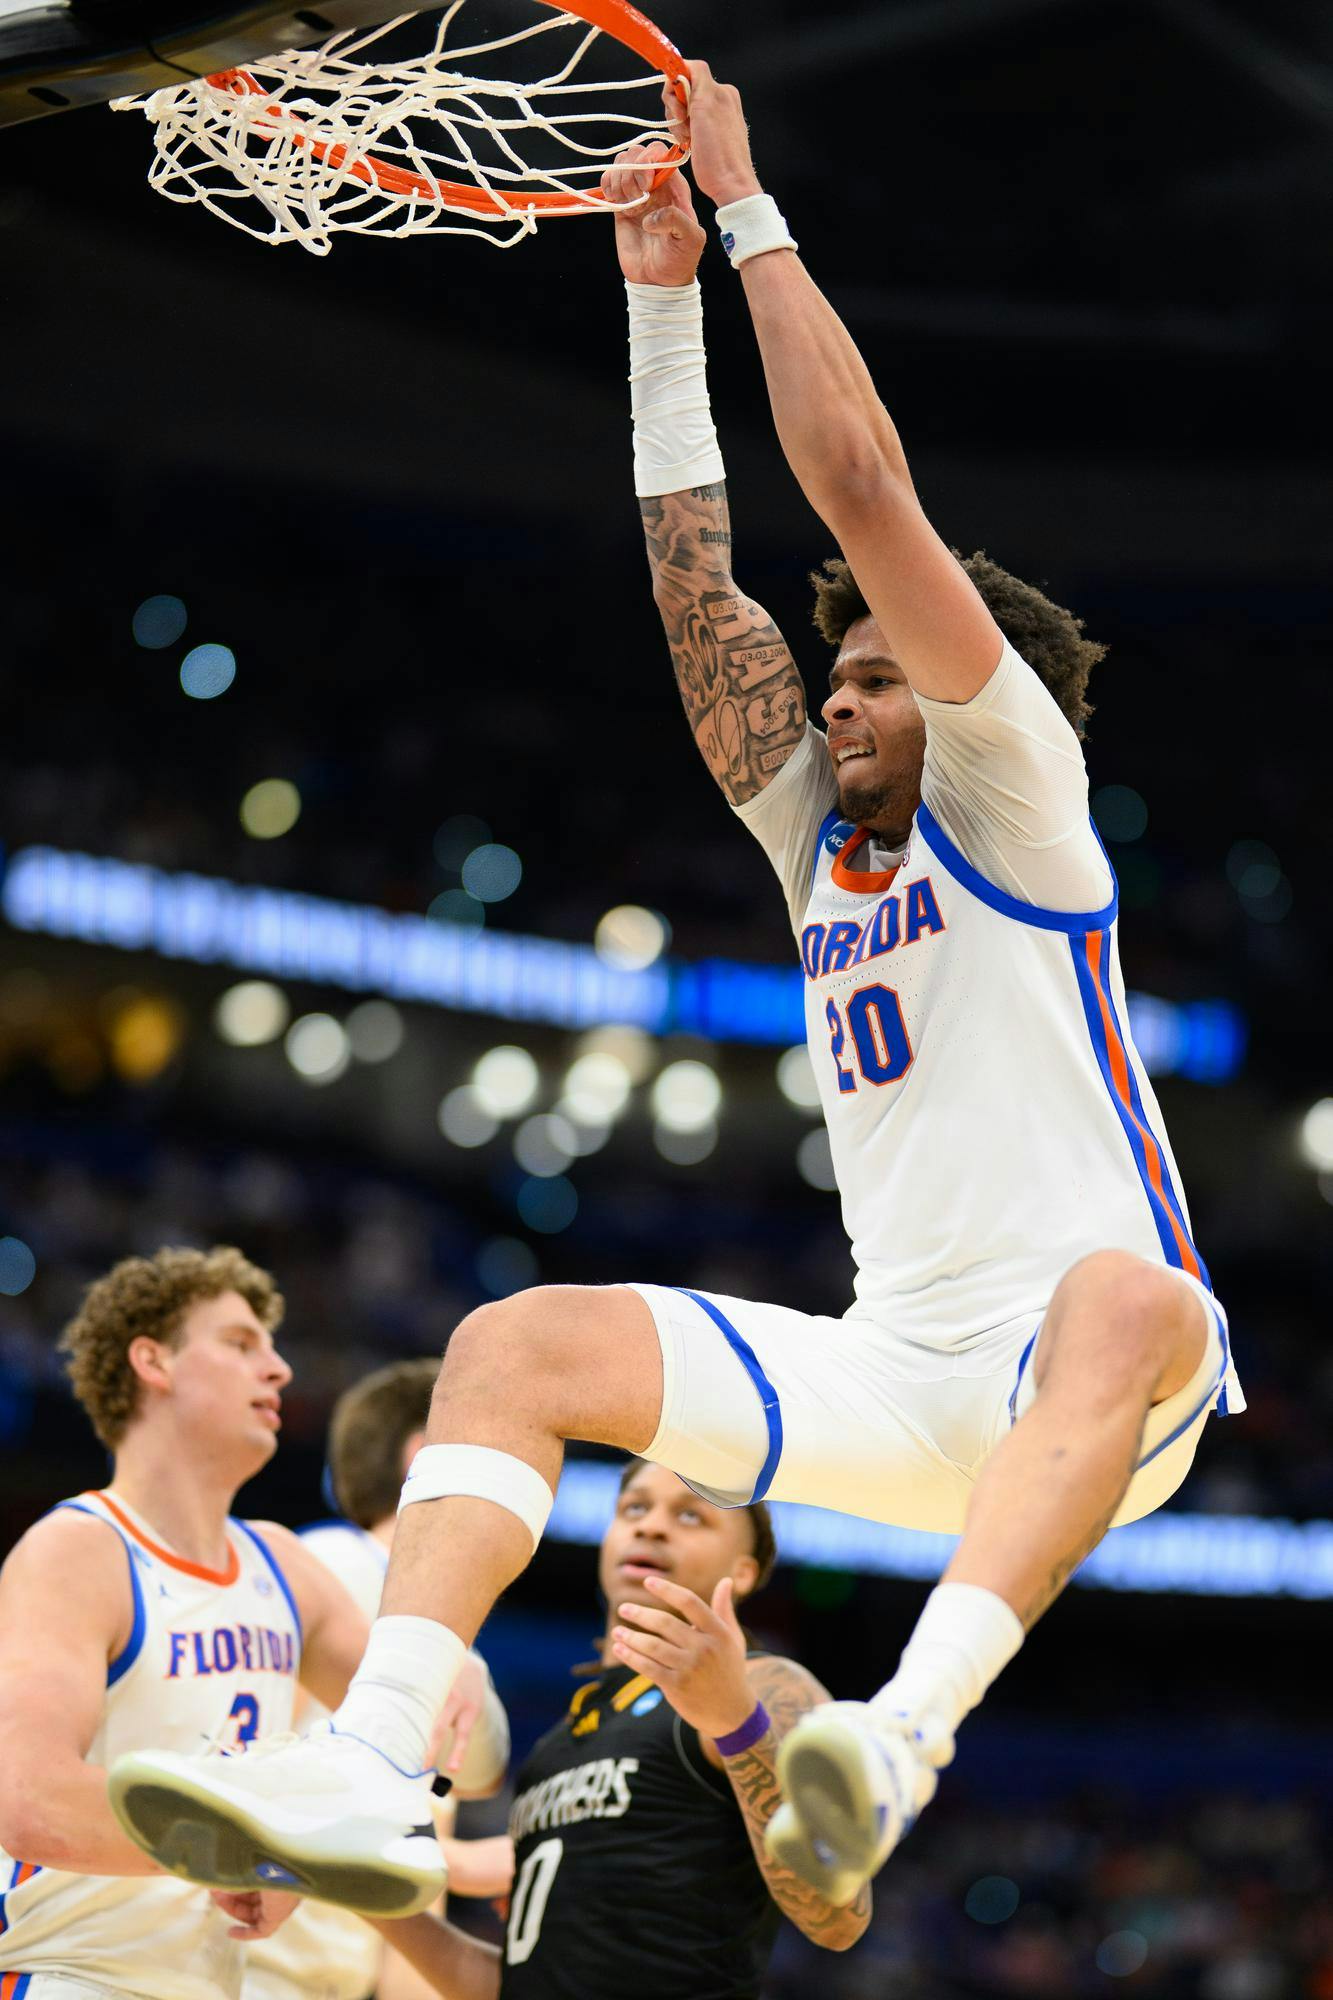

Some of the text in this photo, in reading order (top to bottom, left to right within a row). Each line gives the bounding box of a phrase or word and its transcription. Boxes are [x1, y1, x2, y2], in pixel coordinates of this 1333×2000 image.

[828, 833, 846, 848] NC
[801, 876, 946, 982] ORIDA
[825, 982, 914, 1093] 20
[229, 1691, 260, 1757] 3
[506, 1837, 564, 1966] 0
